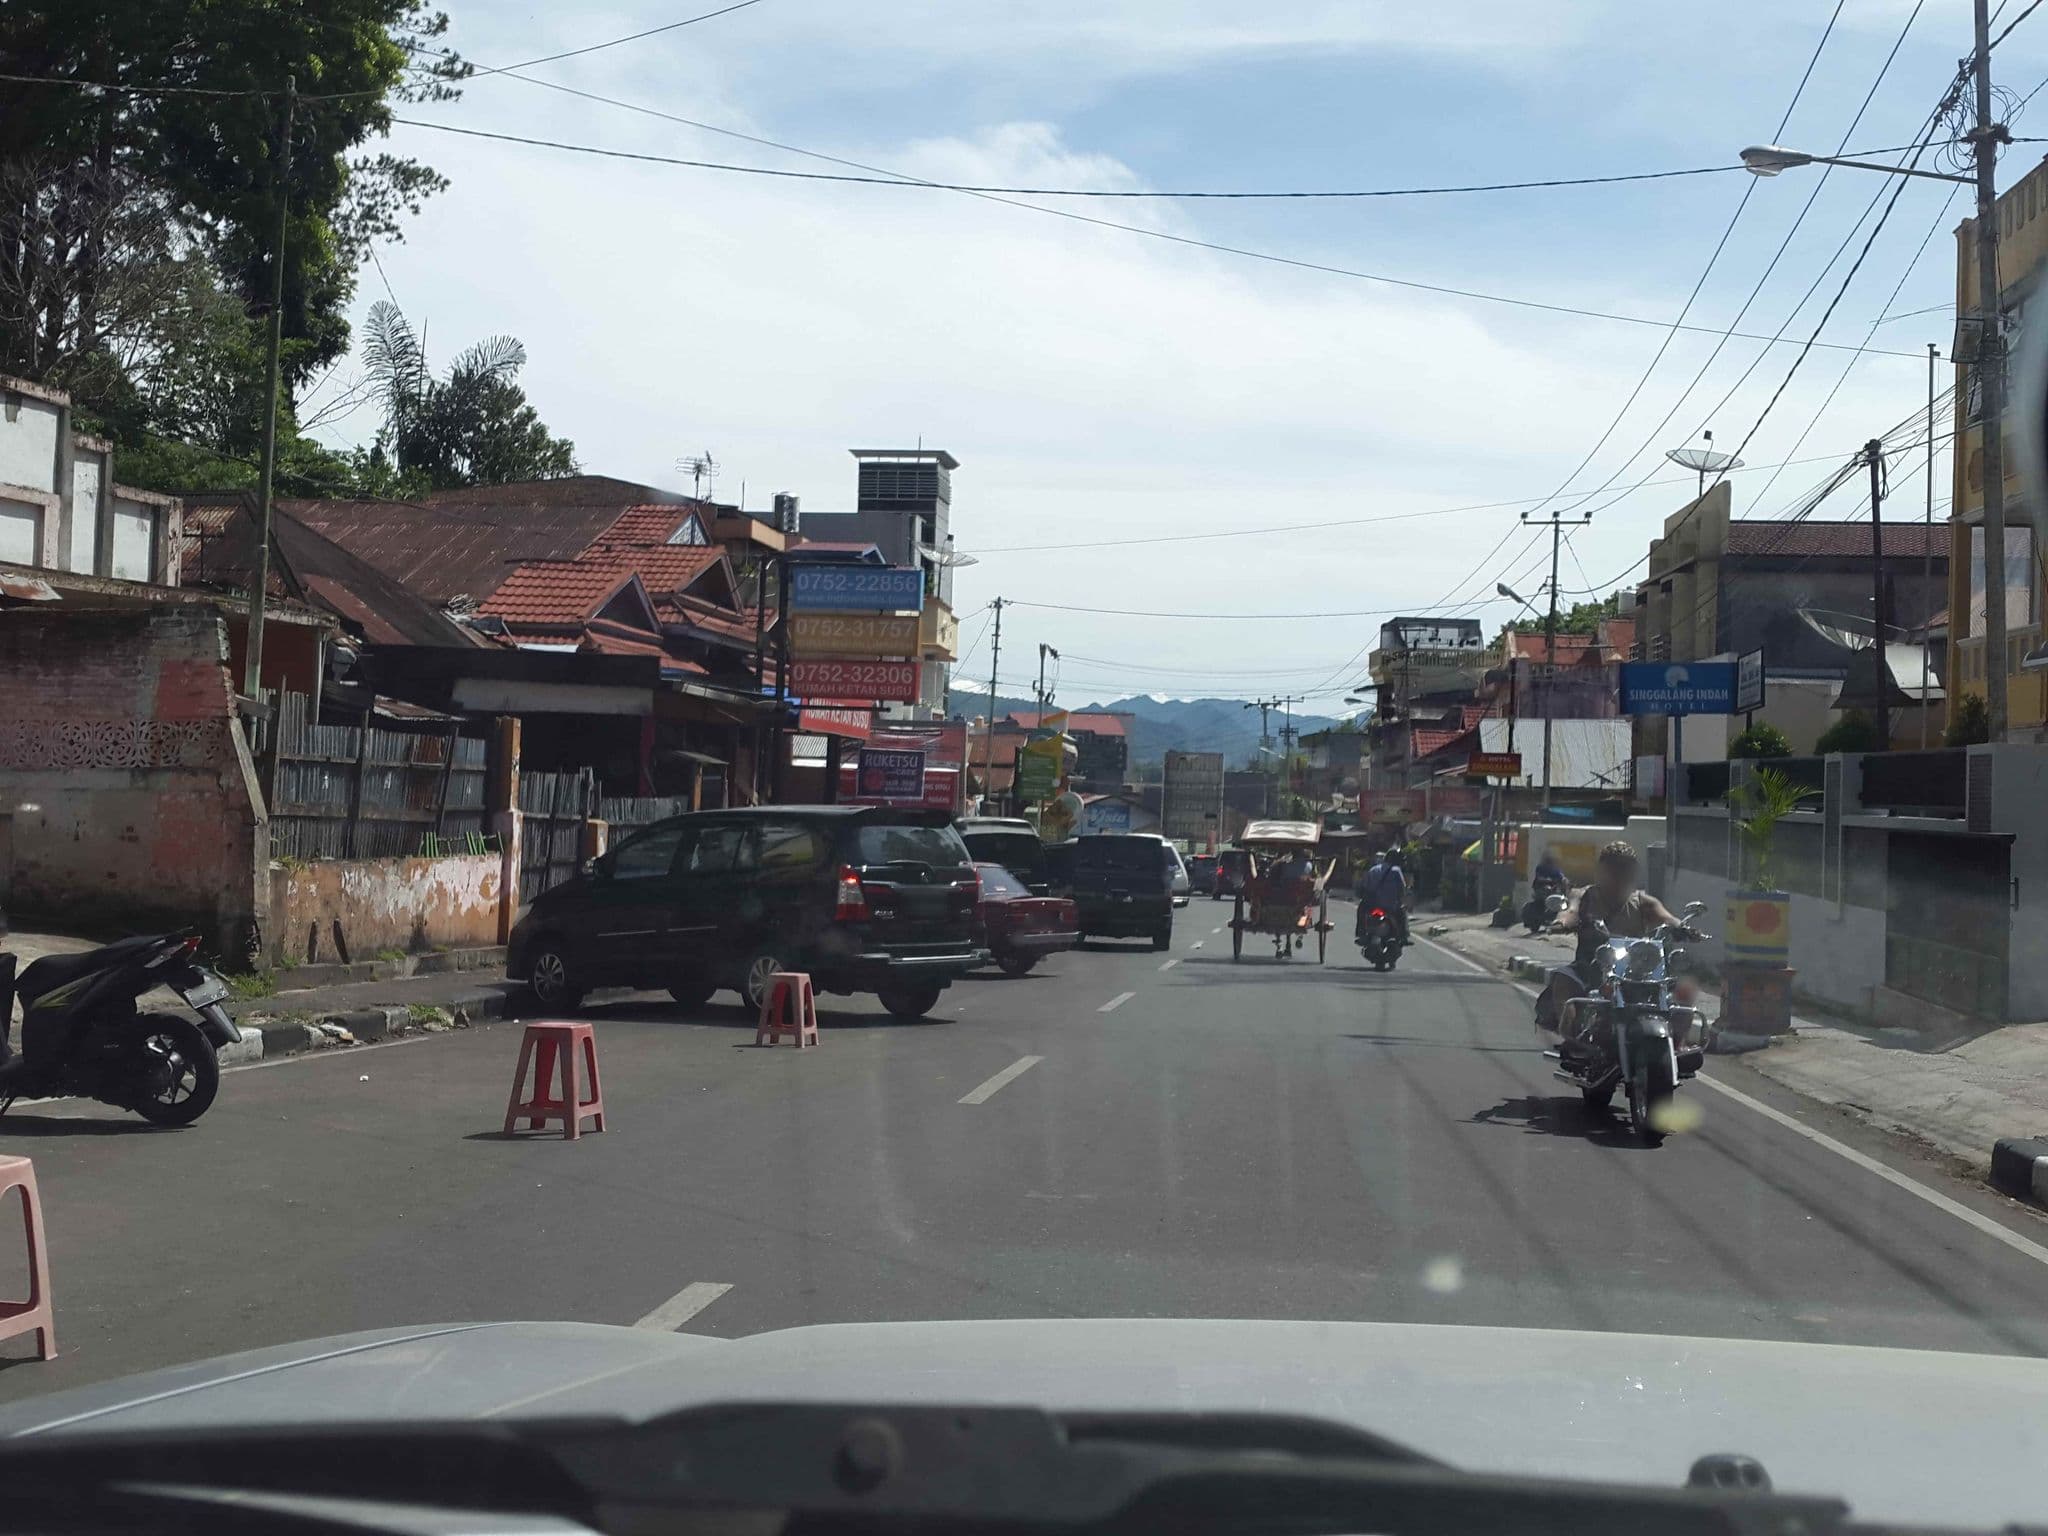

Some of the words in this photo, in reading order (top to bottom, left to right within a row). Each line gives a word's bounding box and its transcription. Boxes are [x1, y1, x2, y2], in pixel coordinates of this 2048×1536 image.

[797, 573, 917, 592] 0752-22856
[796, 618, 914, 638] 0752-31757
[793, 664, 913, 684] 0752-32306
[793, 684, 836, 696] RUMAH
[838, 684, 877, 696] KETAN
[880, 685, 912, 697] SUSU
[1629, 688, 1694, 701] SINGGALANG
[1697, 688, 1729, 701] INDAH
[1650, 702, 1706, 711] HOTEL
[864, 753, 919, 768] RUKETSU
